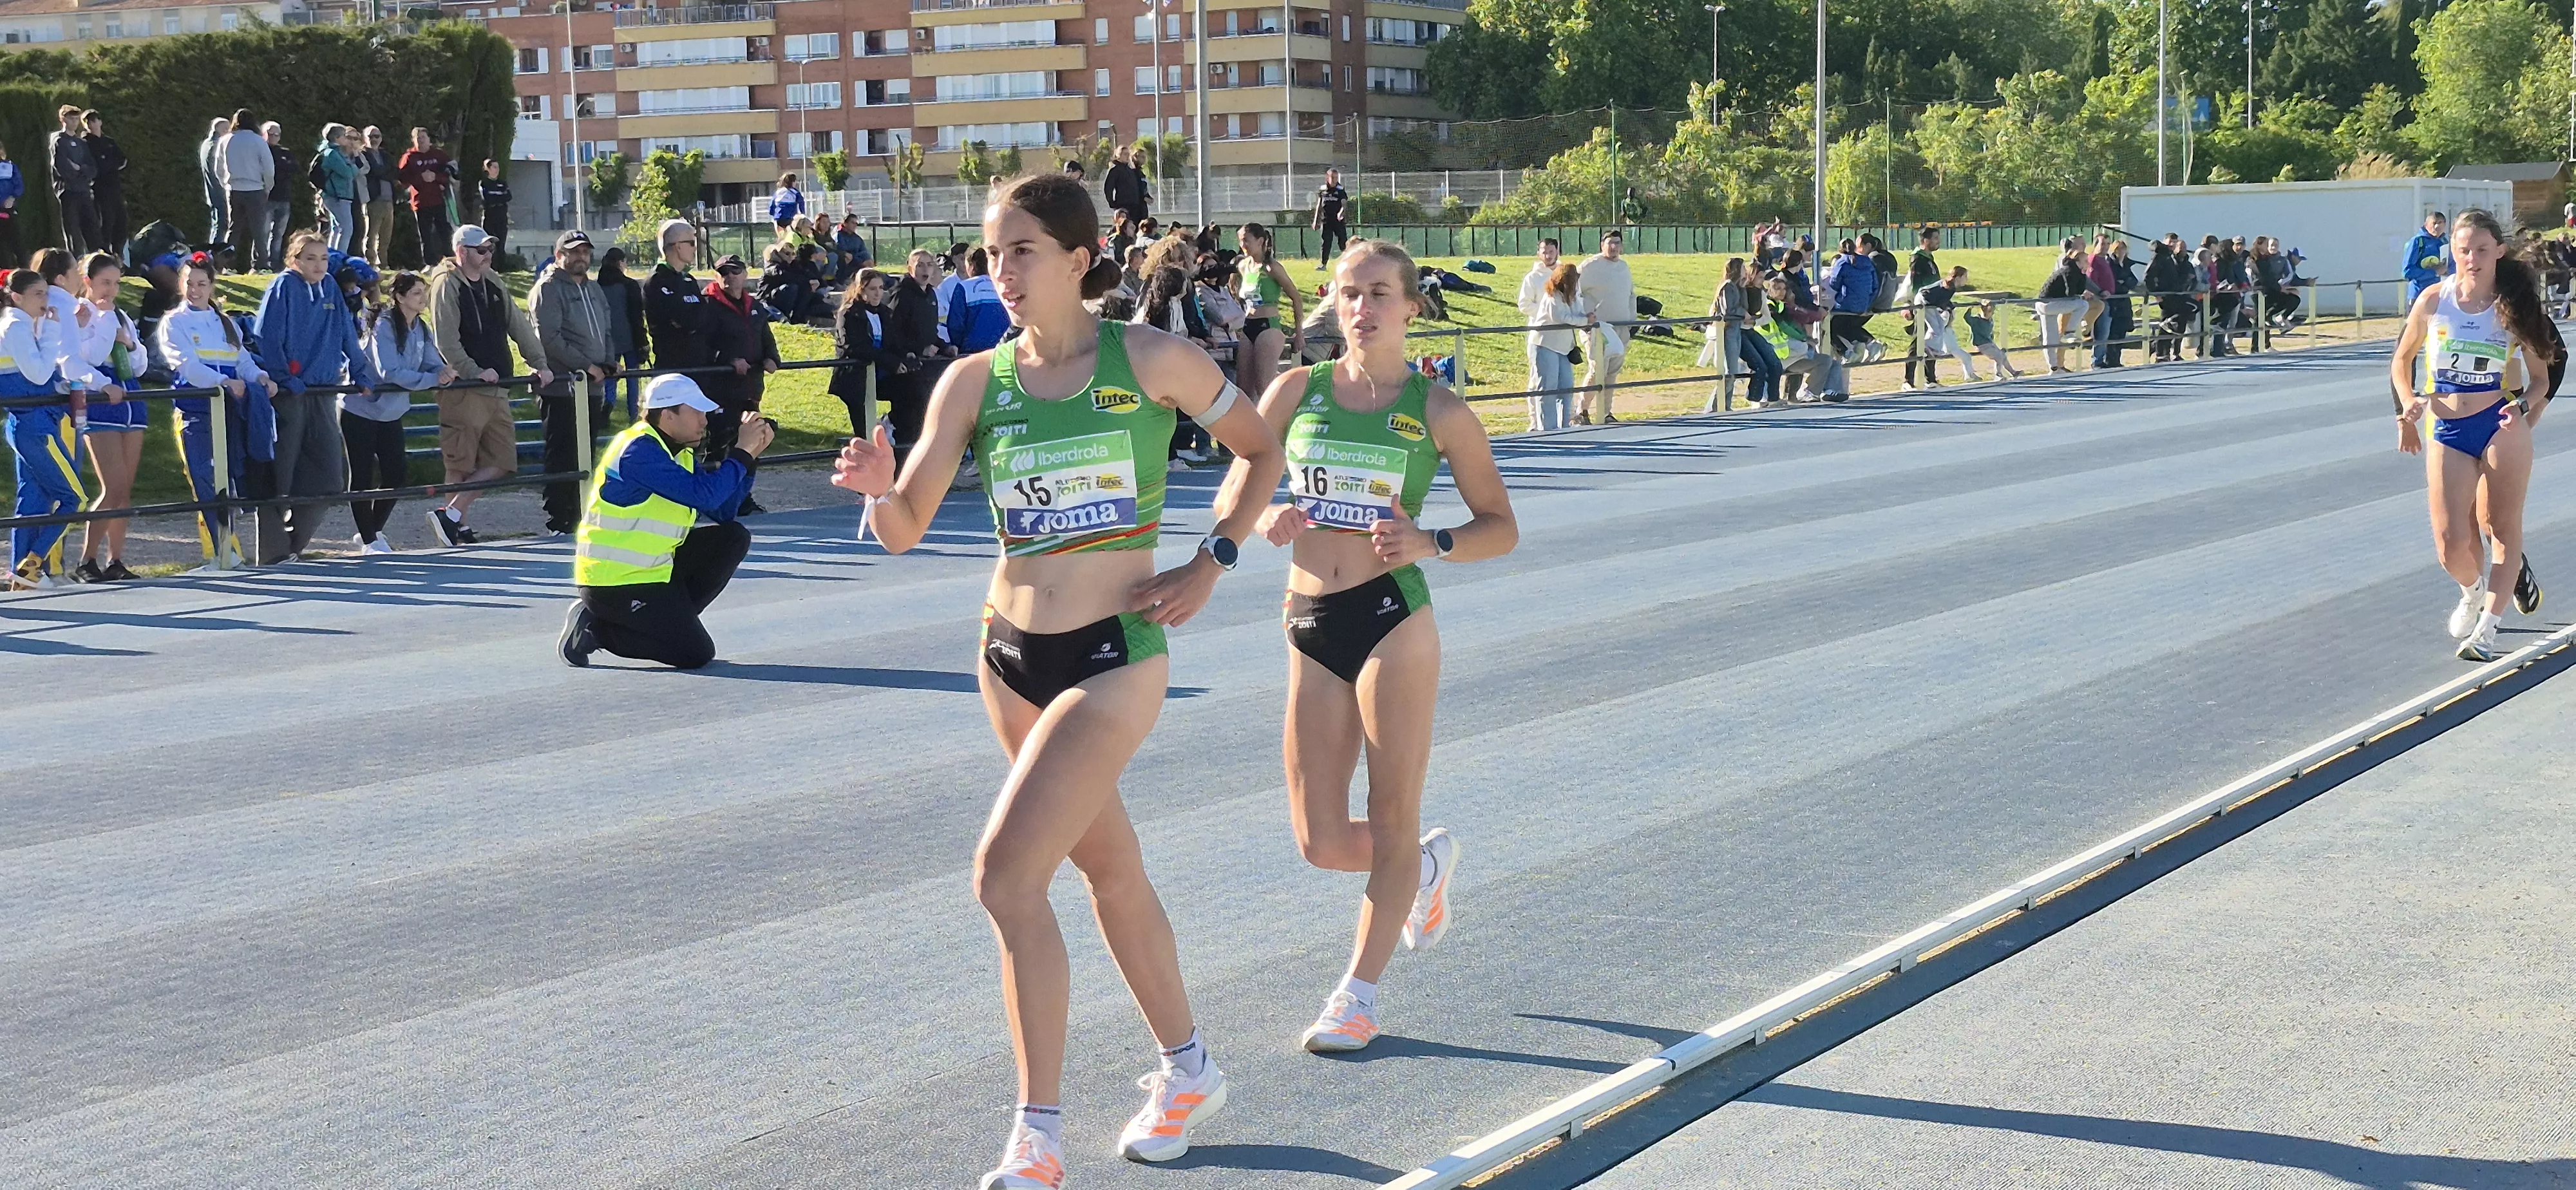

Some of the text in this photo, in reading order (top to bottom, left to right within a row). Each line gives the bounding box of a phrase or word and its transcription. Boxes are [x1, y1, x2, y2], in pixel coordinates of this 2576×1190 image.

[2451, 353, 2459, 369] 2
[1038, 442, 1109, 466] Iberdrola
[1327, 448, 1387, 465] Iberdrola
[1014, 476, 1052, 506] 15
[1302, 466, 1328, 496] 16
